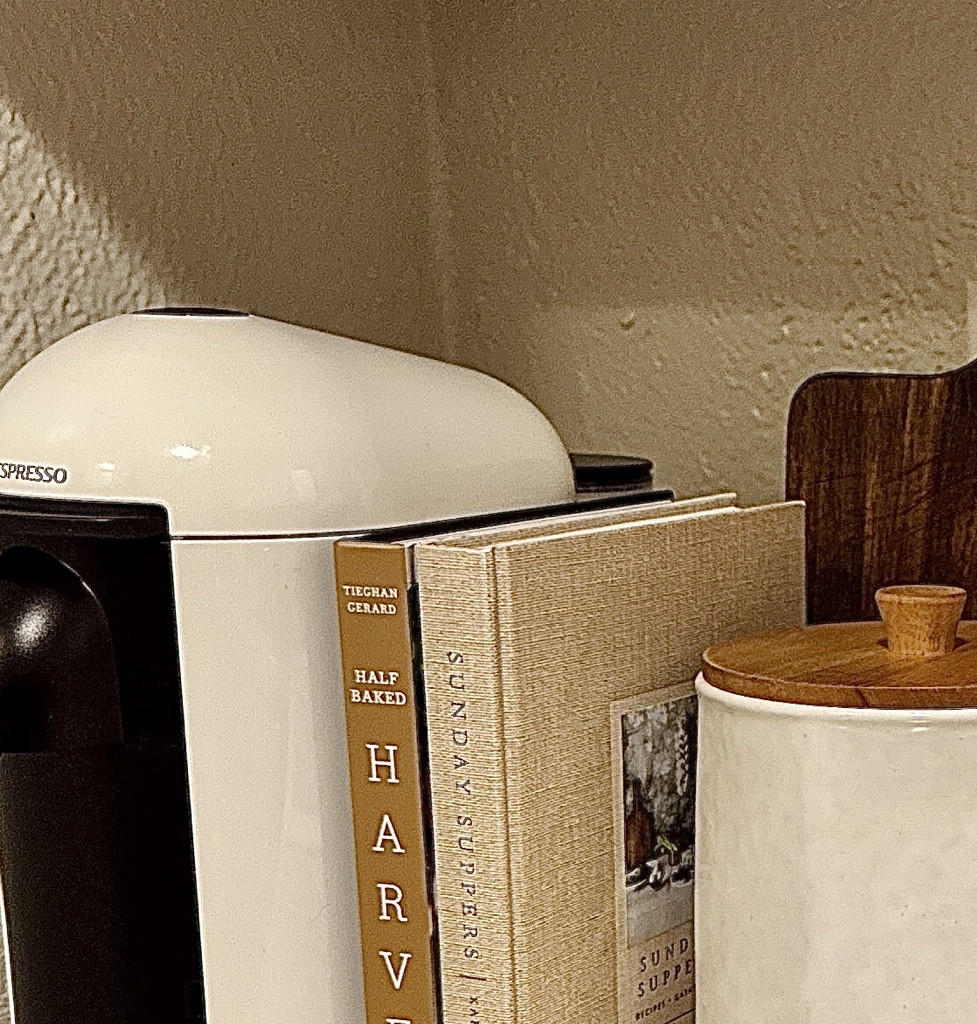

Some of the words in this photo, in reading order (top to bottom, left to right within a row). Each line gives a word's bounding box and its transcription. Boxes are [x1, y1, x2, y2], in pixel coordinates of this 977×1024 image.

[342, 585, 398, 599] TIEGHAN
[347, 601, 397, 615] GERARD
[354, 669, 399, 686] HALF
[350, 689, 406, 706] BAKED
[446, 651, 471, 795] SUNDAY
[457, 815, 479, 959] SUPPERS
